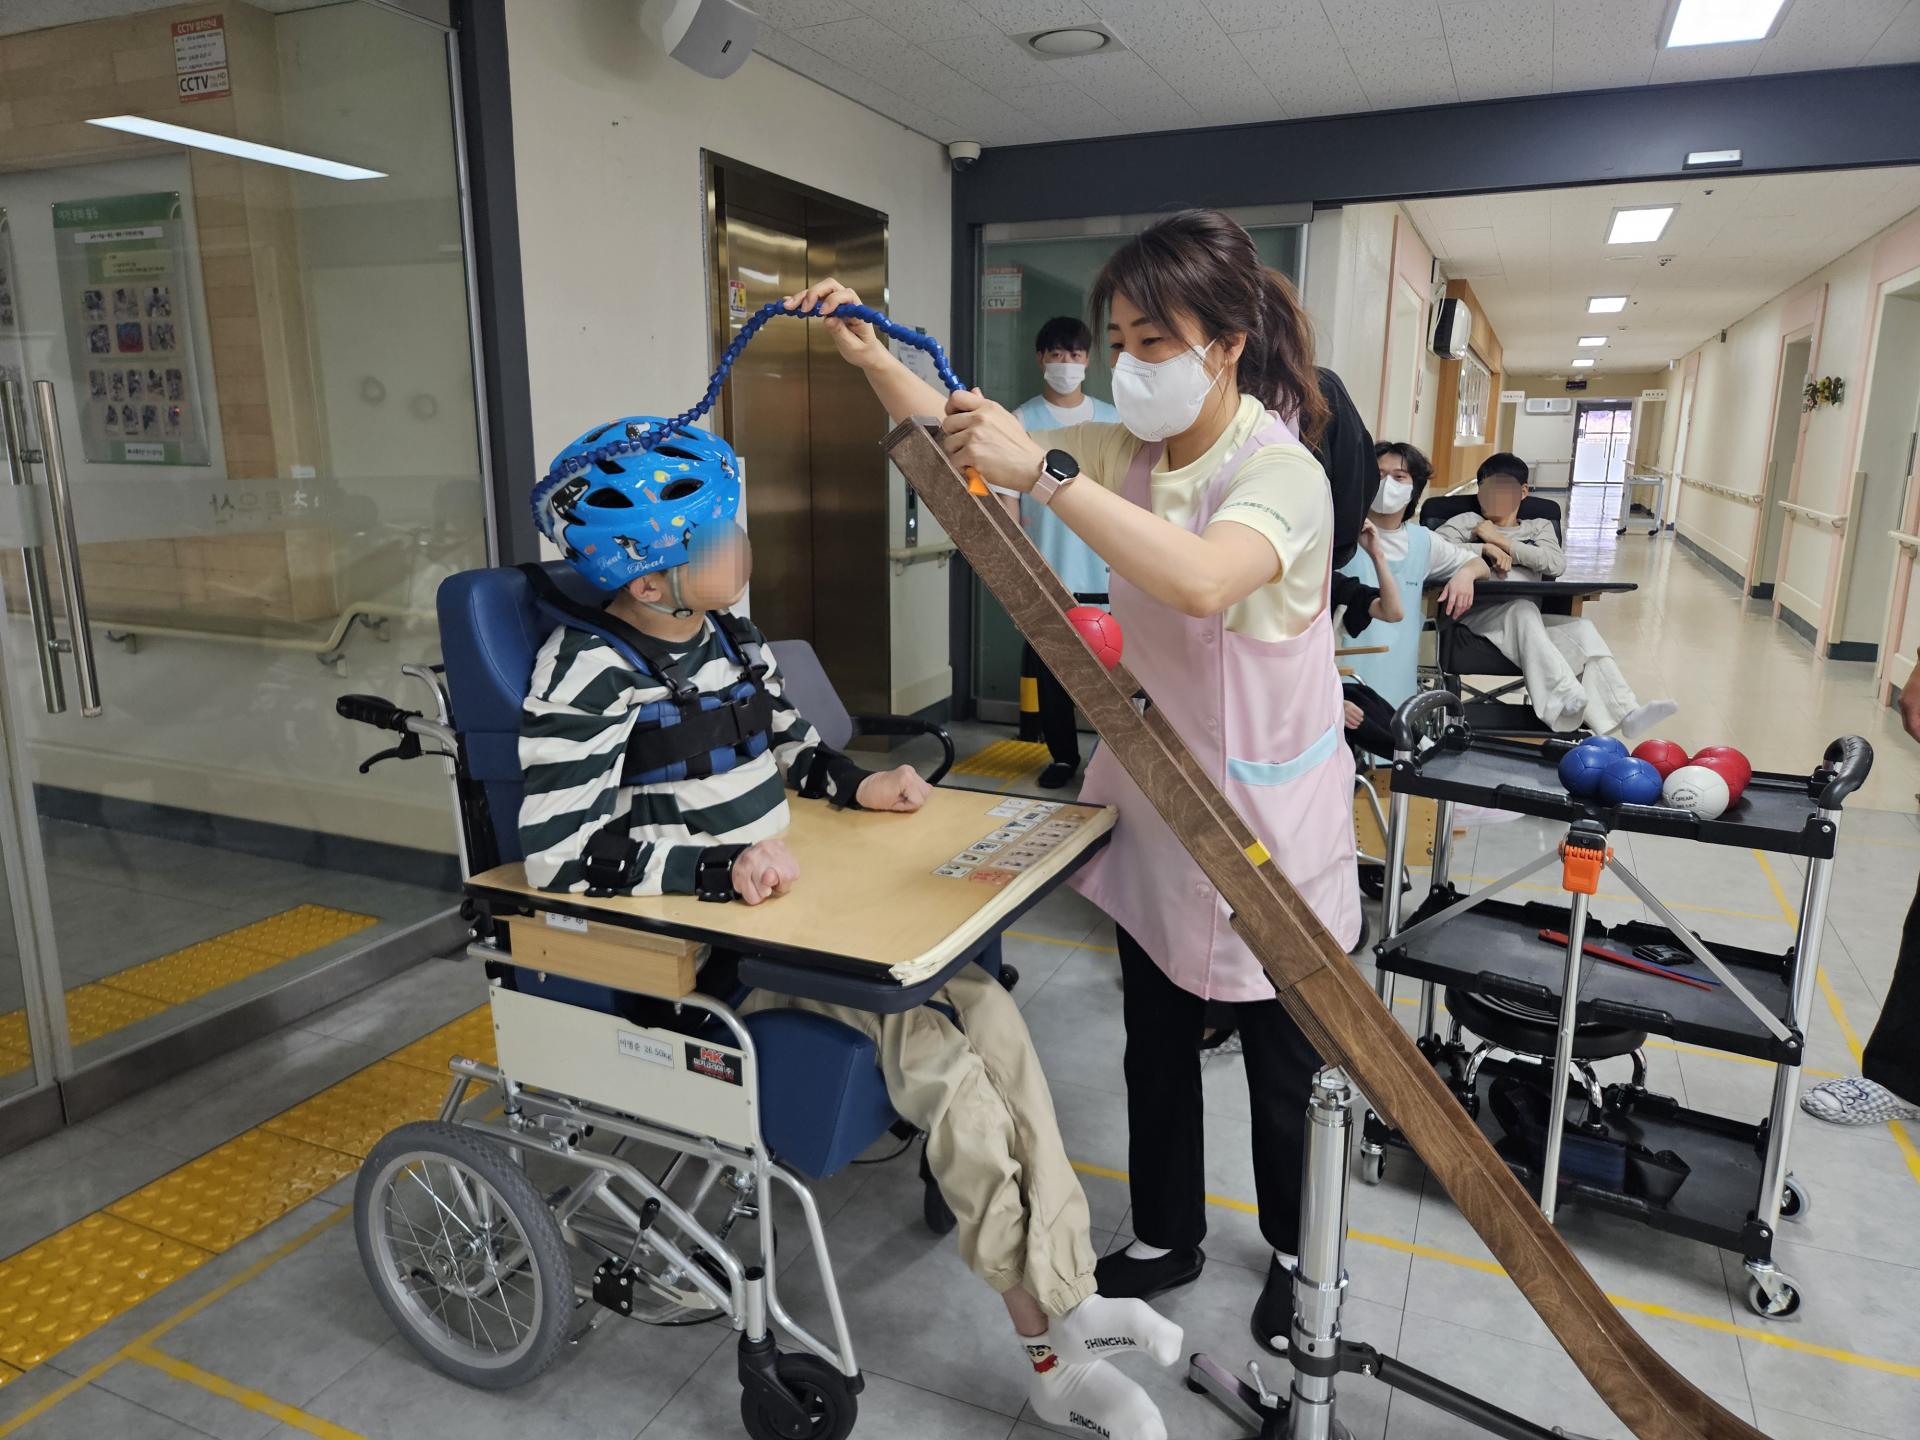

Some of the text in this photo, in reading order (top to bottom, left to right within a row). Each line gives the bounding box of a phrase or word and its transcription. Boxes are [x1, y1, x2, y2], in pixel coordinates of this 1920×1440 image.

[177, 22, 194, 33] CCTV
[180, 75, 208, 92] CCTV
[1084, 1336, 1137, 1350] SHINCHAN
[1069, 1410, 1111, 1439] SHINCHAN
